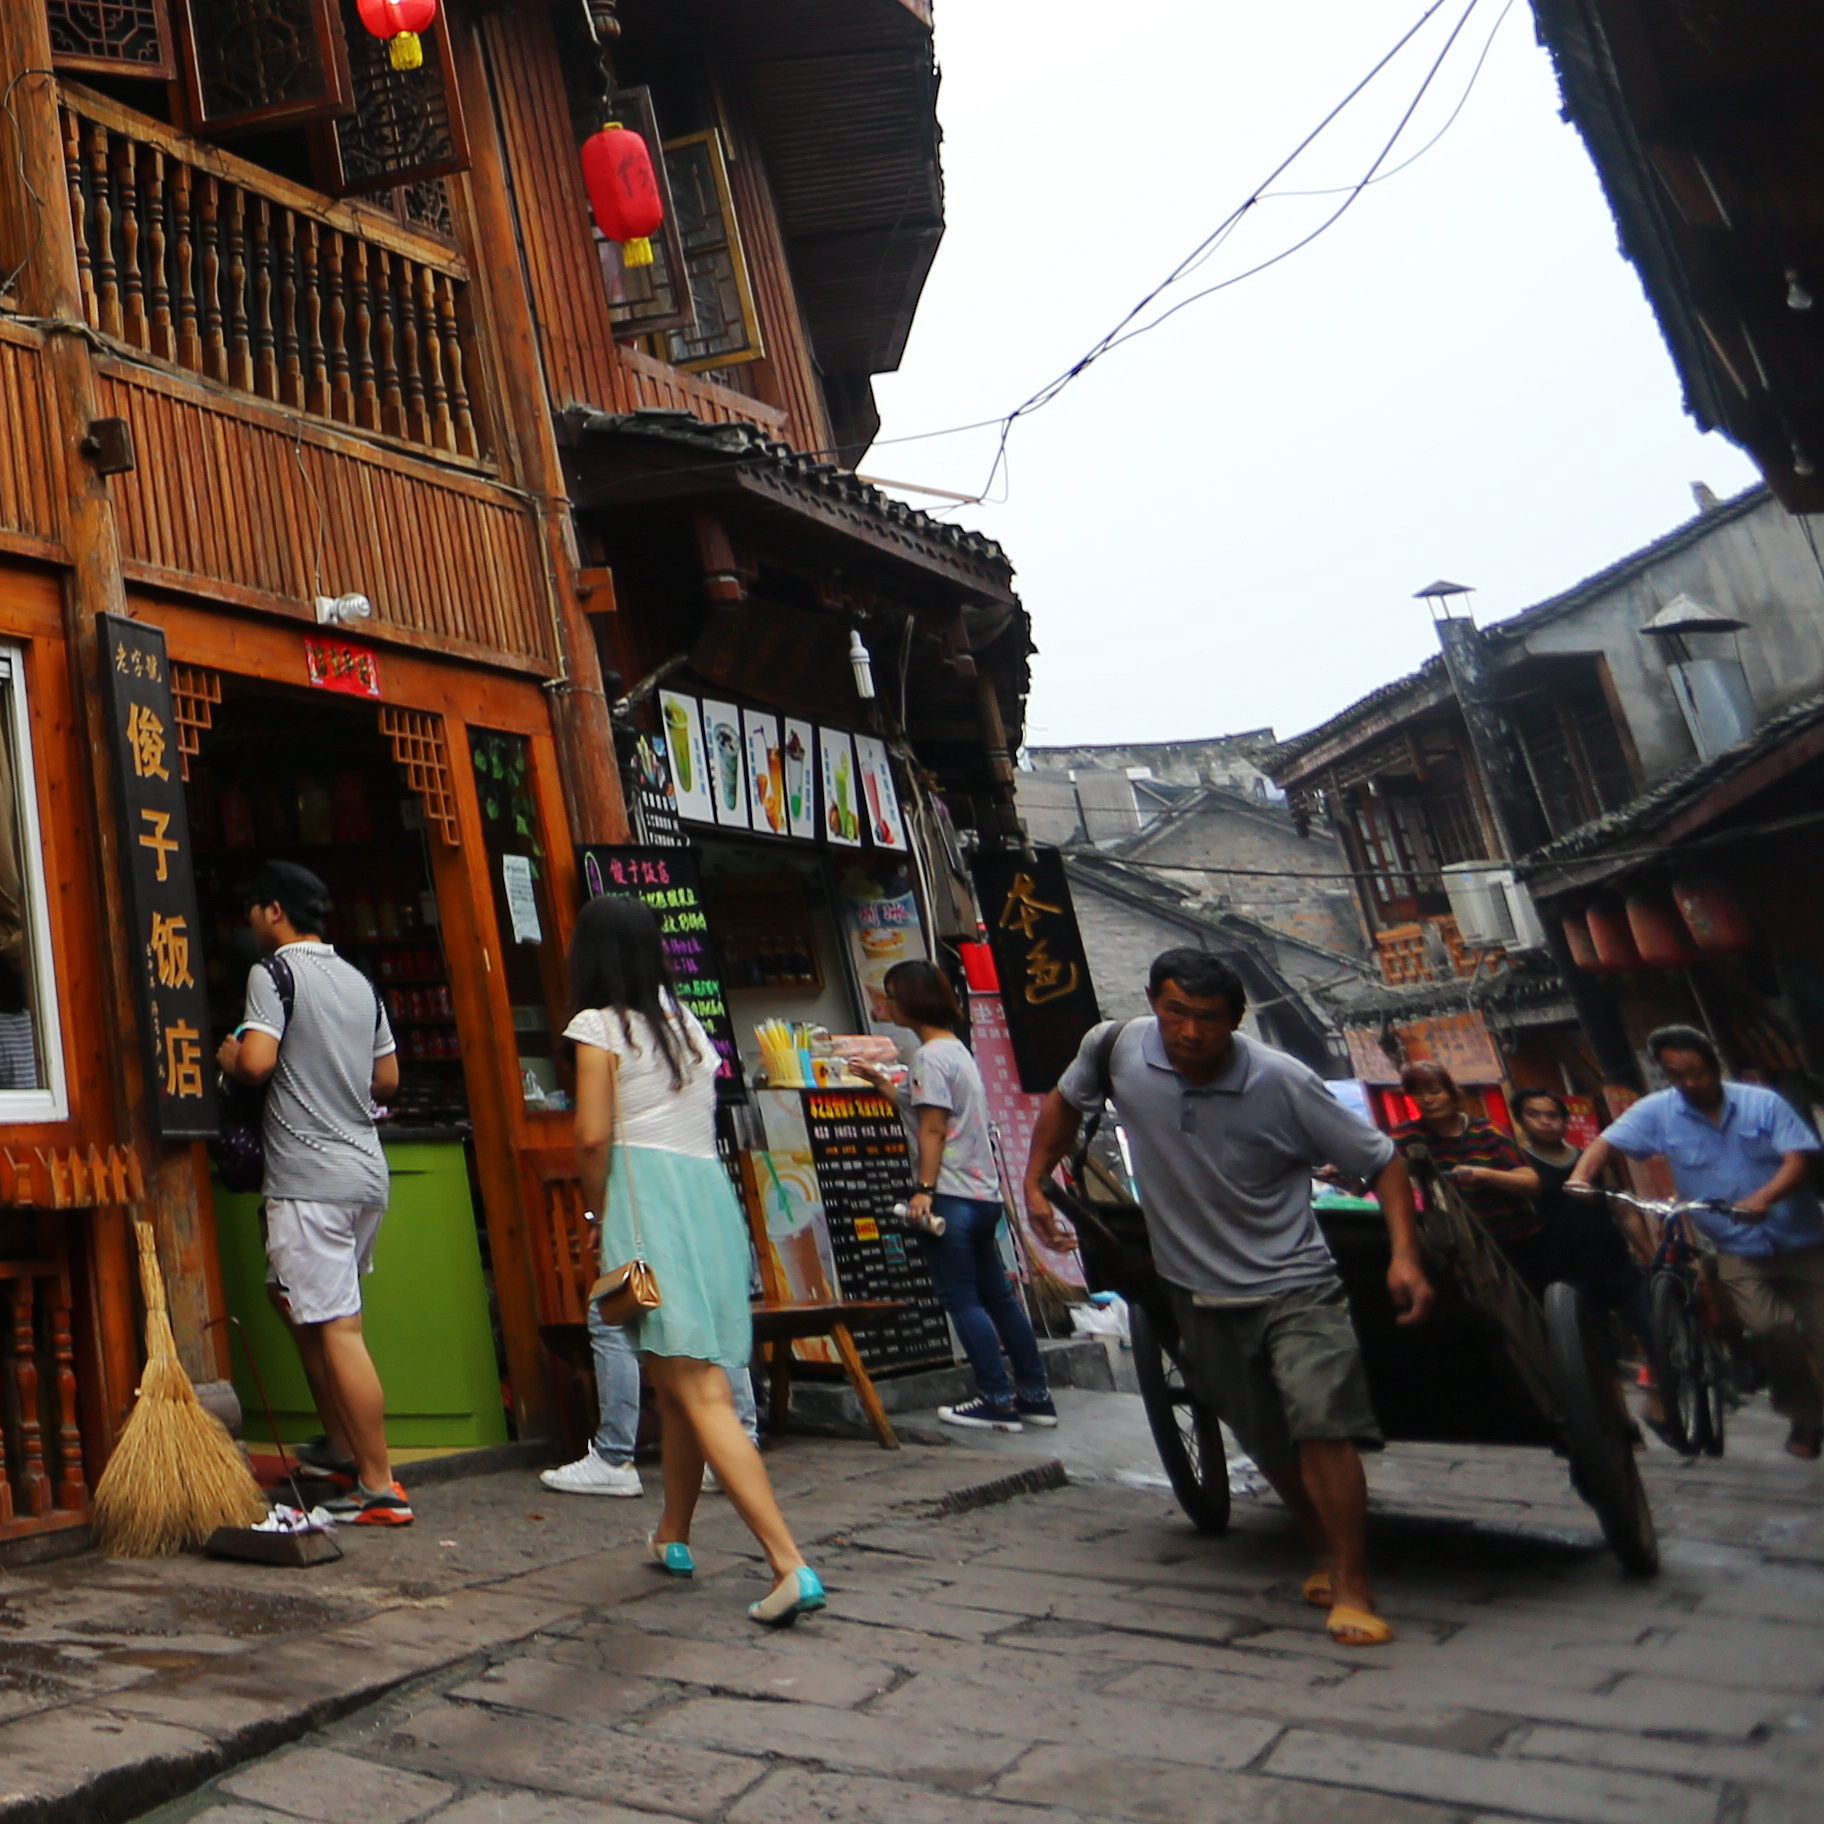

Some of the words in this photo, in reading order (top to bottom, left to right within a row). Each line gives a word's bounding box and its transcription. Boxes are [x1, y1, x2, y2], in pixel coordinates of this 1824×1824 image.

[126, 701, 204, 1099] 俊子饭店
[999, 872, 1080, 1005] 本色
